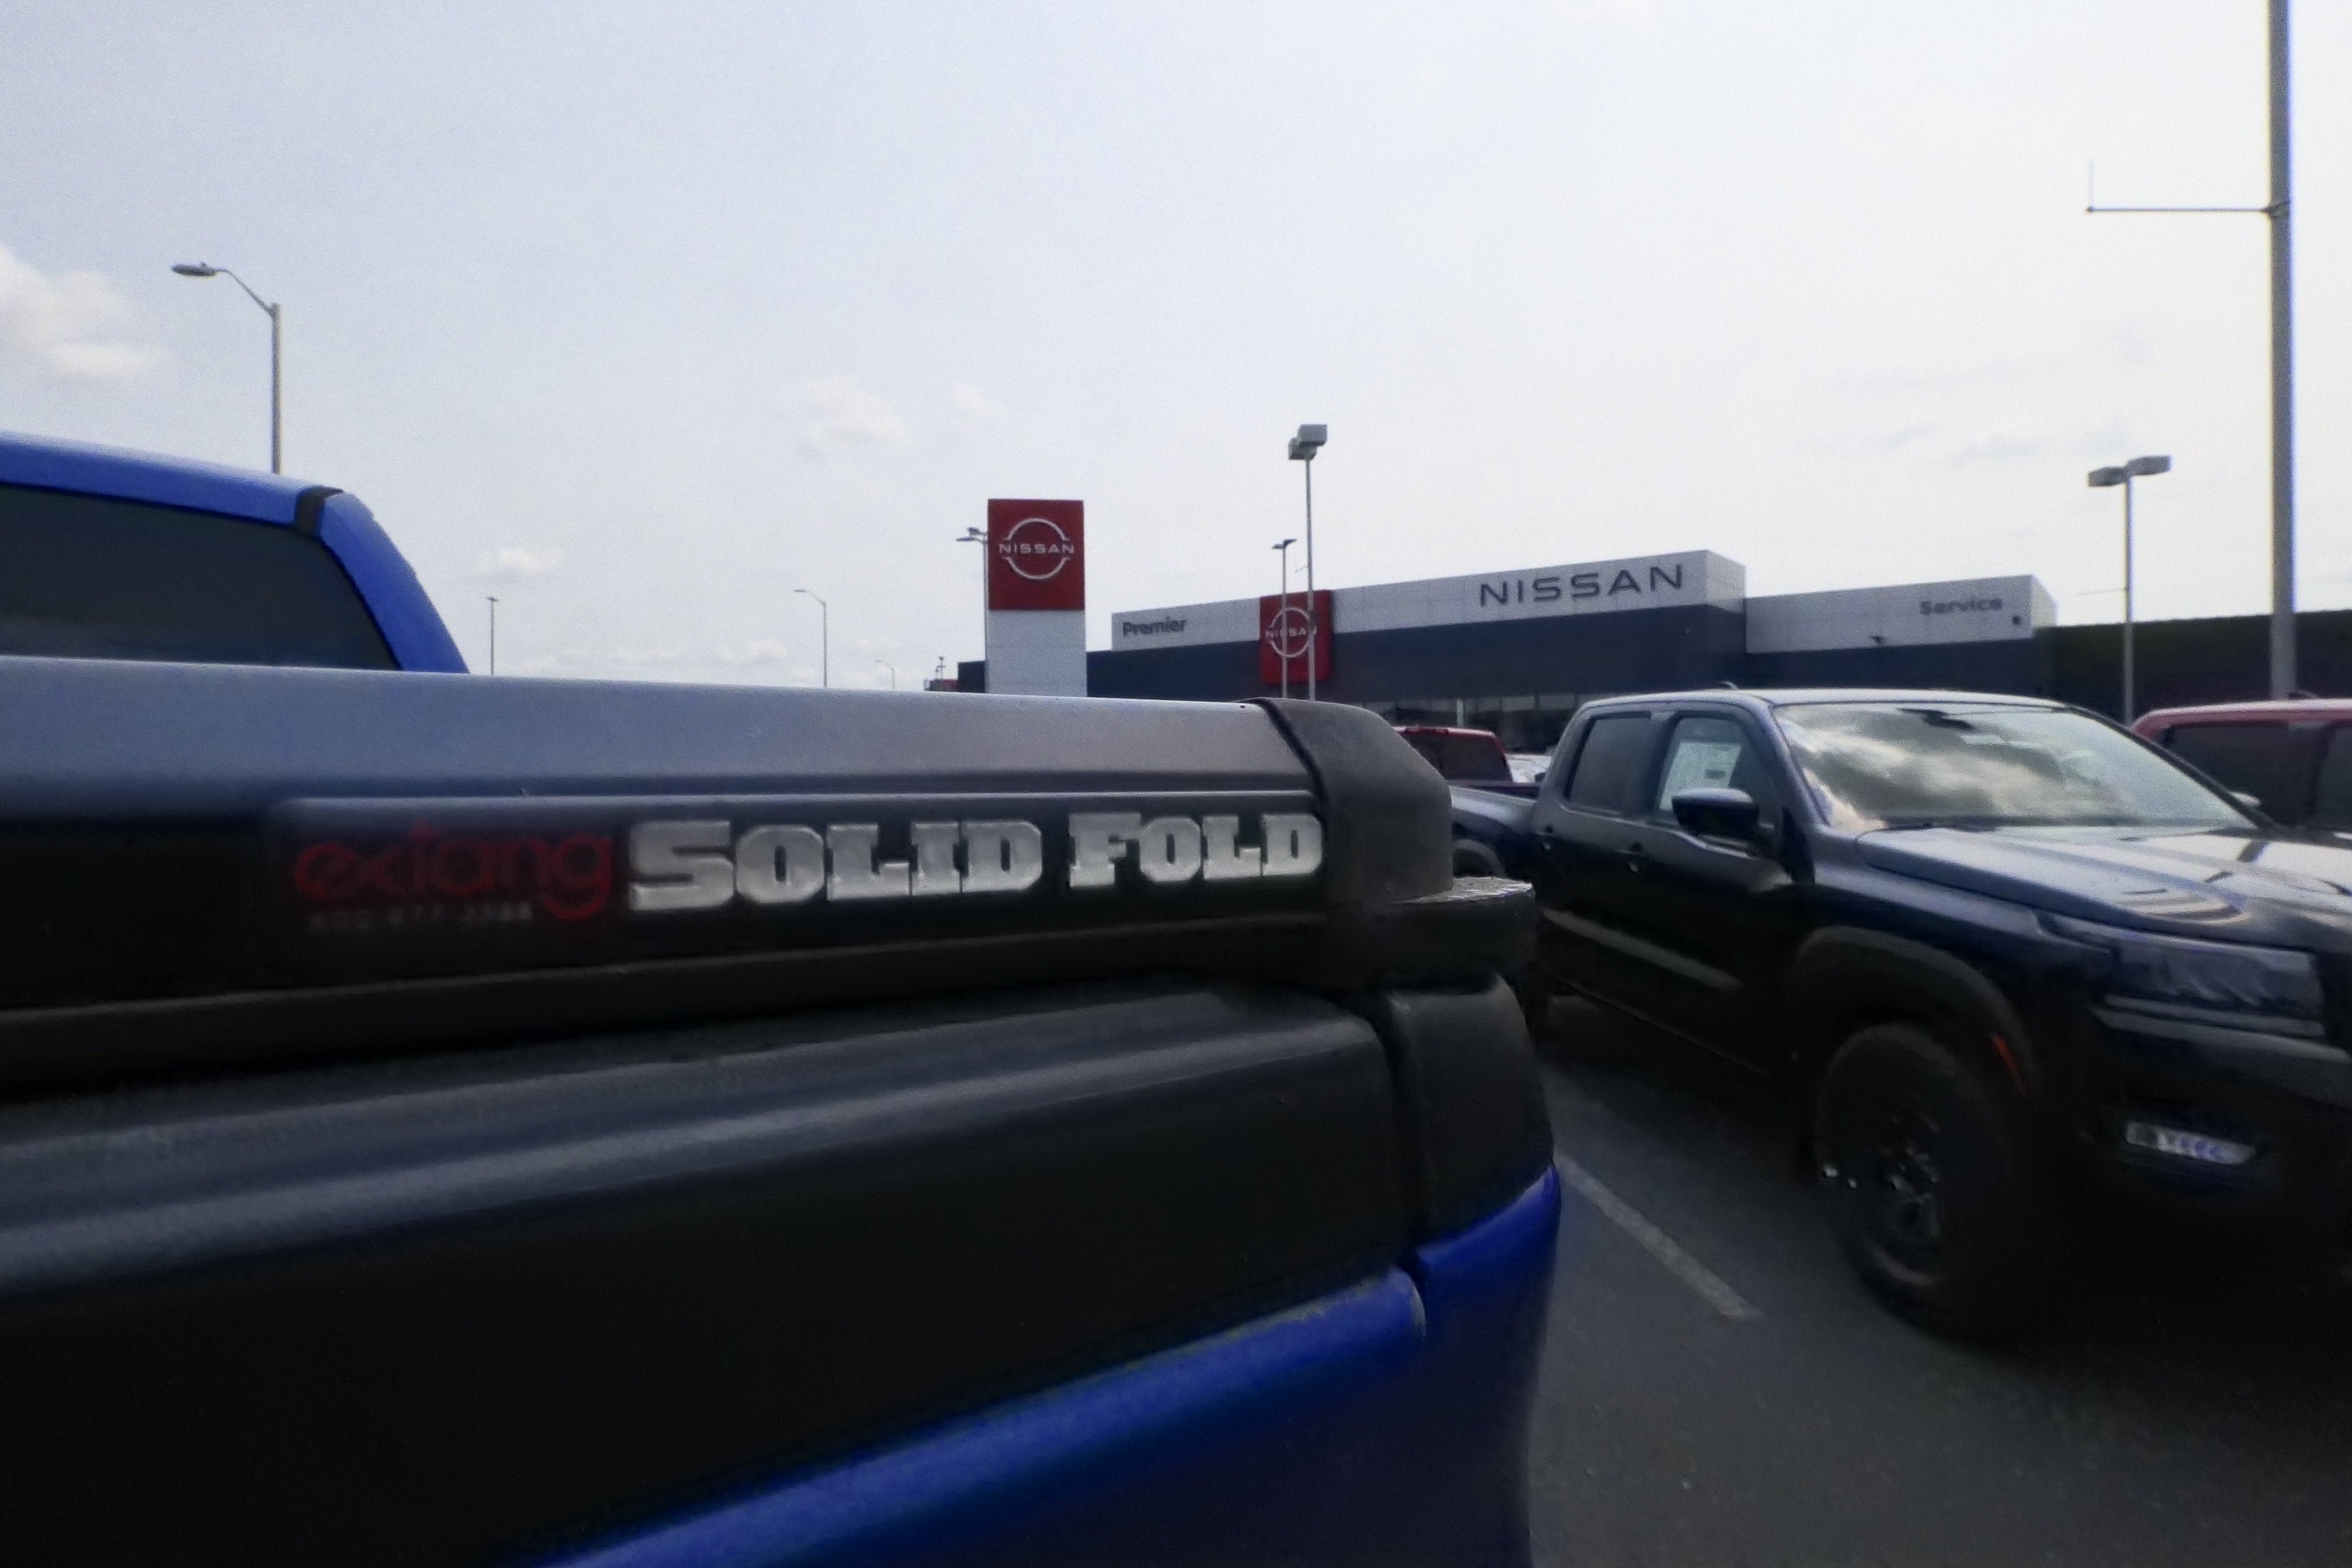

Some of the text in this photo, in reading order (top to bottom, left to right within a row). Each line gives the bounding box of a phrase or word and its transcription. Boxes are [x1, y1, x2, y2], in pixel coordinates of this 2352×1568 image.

[998, 543, 1074, 555] NISSAN
[1480, 564, 1683, 608] NISSAN
[1919, 596, 2003, 615] Service
[1122, 618, 1186, 637] Premier
[629, 819, 1043, 912] SOLID
[1068, 811, 1322, 890] FOLD
